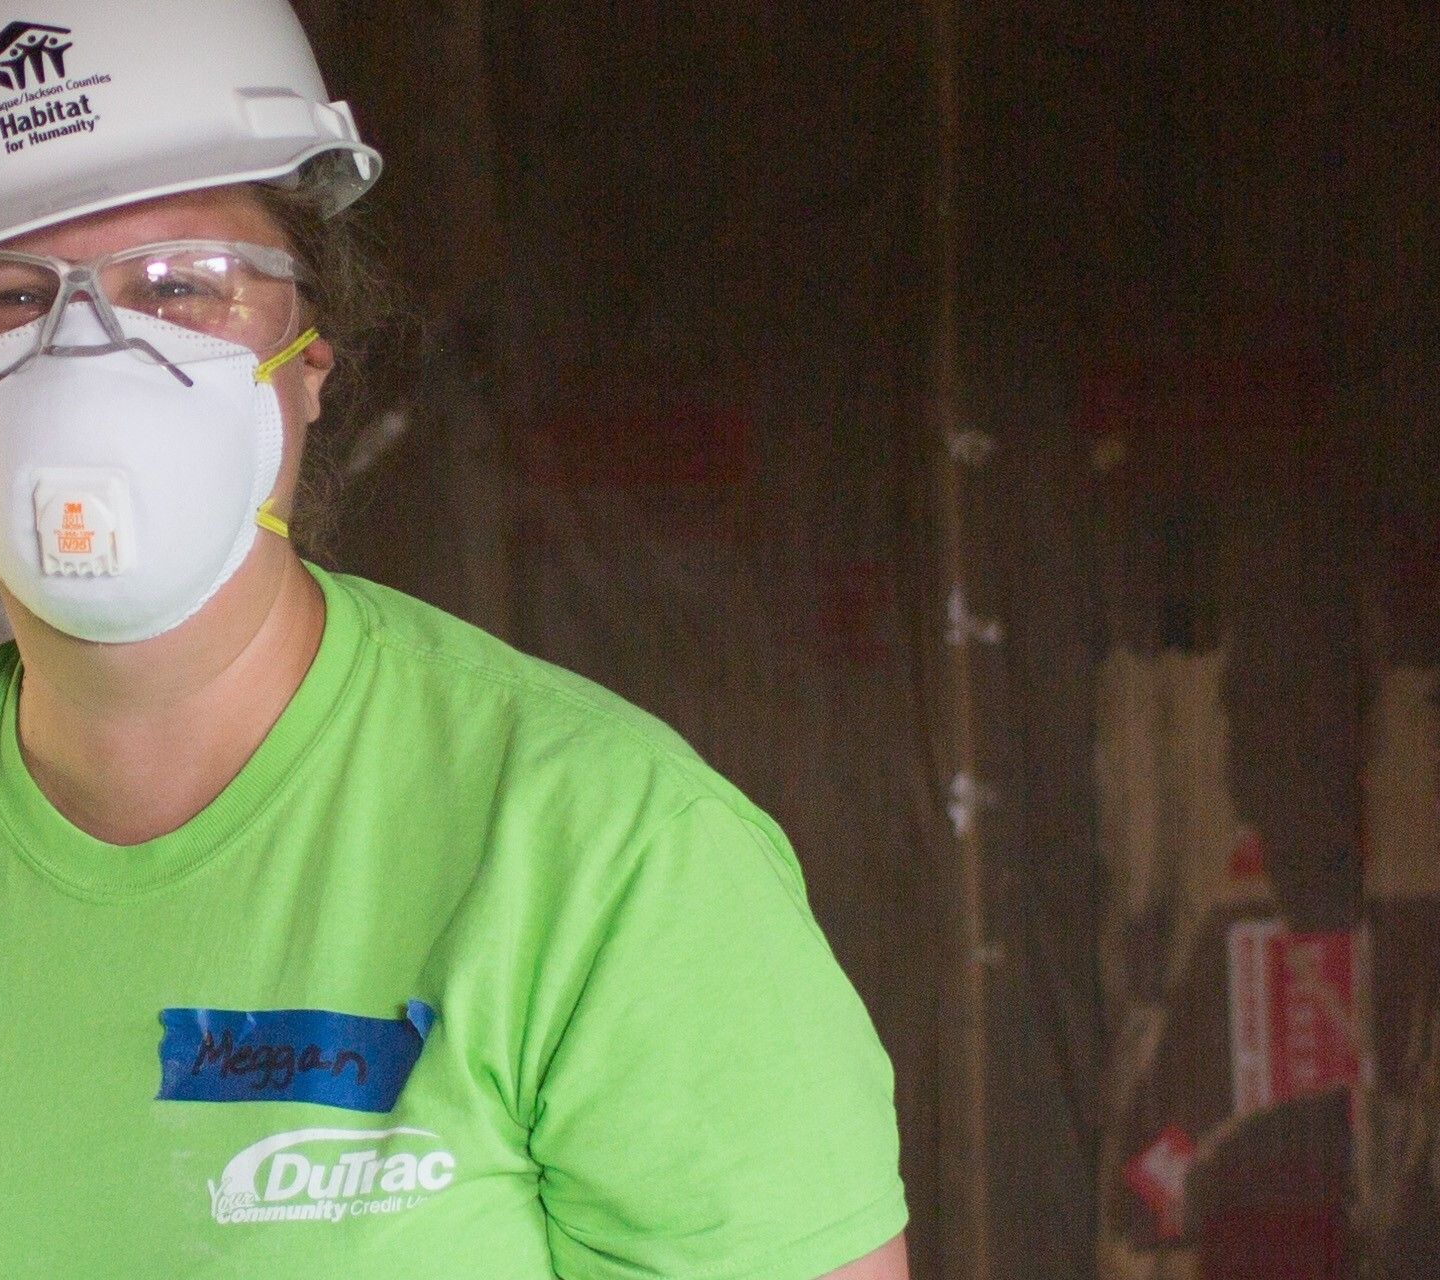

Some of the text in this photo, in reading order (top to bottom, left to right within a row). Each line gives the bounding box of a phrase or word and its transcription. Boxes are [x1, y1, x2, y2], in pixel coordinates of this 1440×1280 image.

[65, 72, 112, 92] Counties
[5, 120, 96, 154] for Humanity
[264, 1149, 455, 1201] DuTrac
[350, 1196, 401, 1216] Credit
